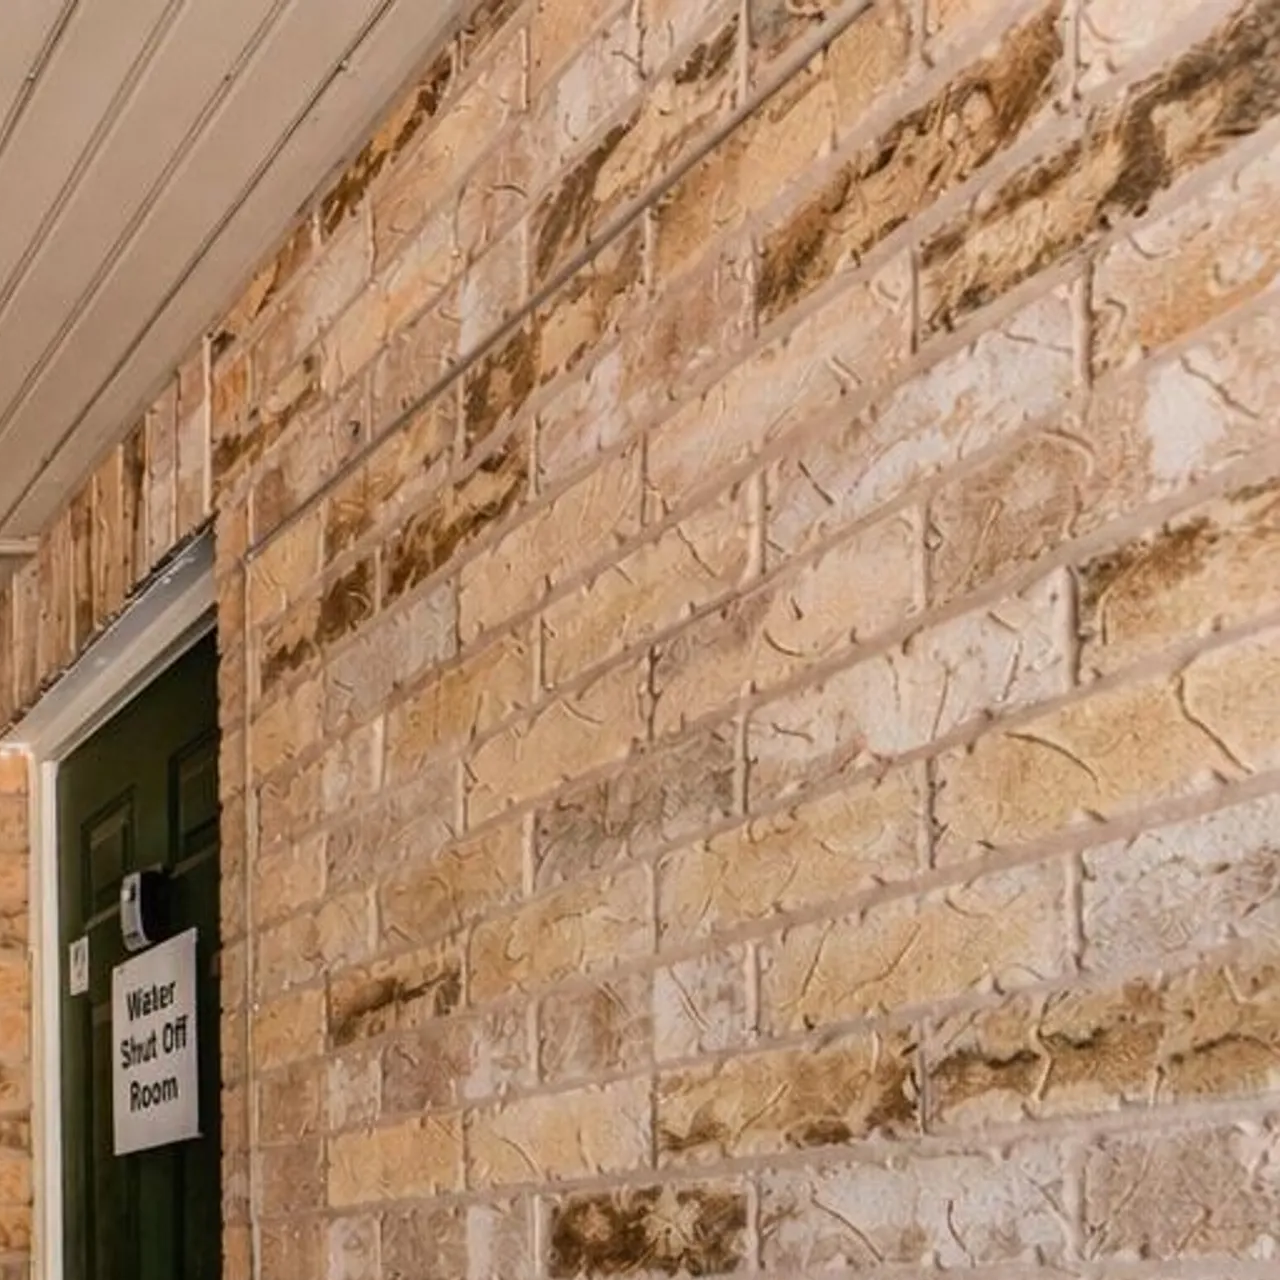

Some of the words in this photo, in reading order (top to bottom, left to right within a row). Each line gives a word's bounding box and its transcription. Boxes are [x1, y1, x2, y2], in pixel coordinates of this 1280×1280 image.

[126, 981, 176, 1021] Water
[120, 1029, 157, 1070] Shut
[162, 1014, 189, 1054] Off
[129, 1076, 179, 1113] Room
